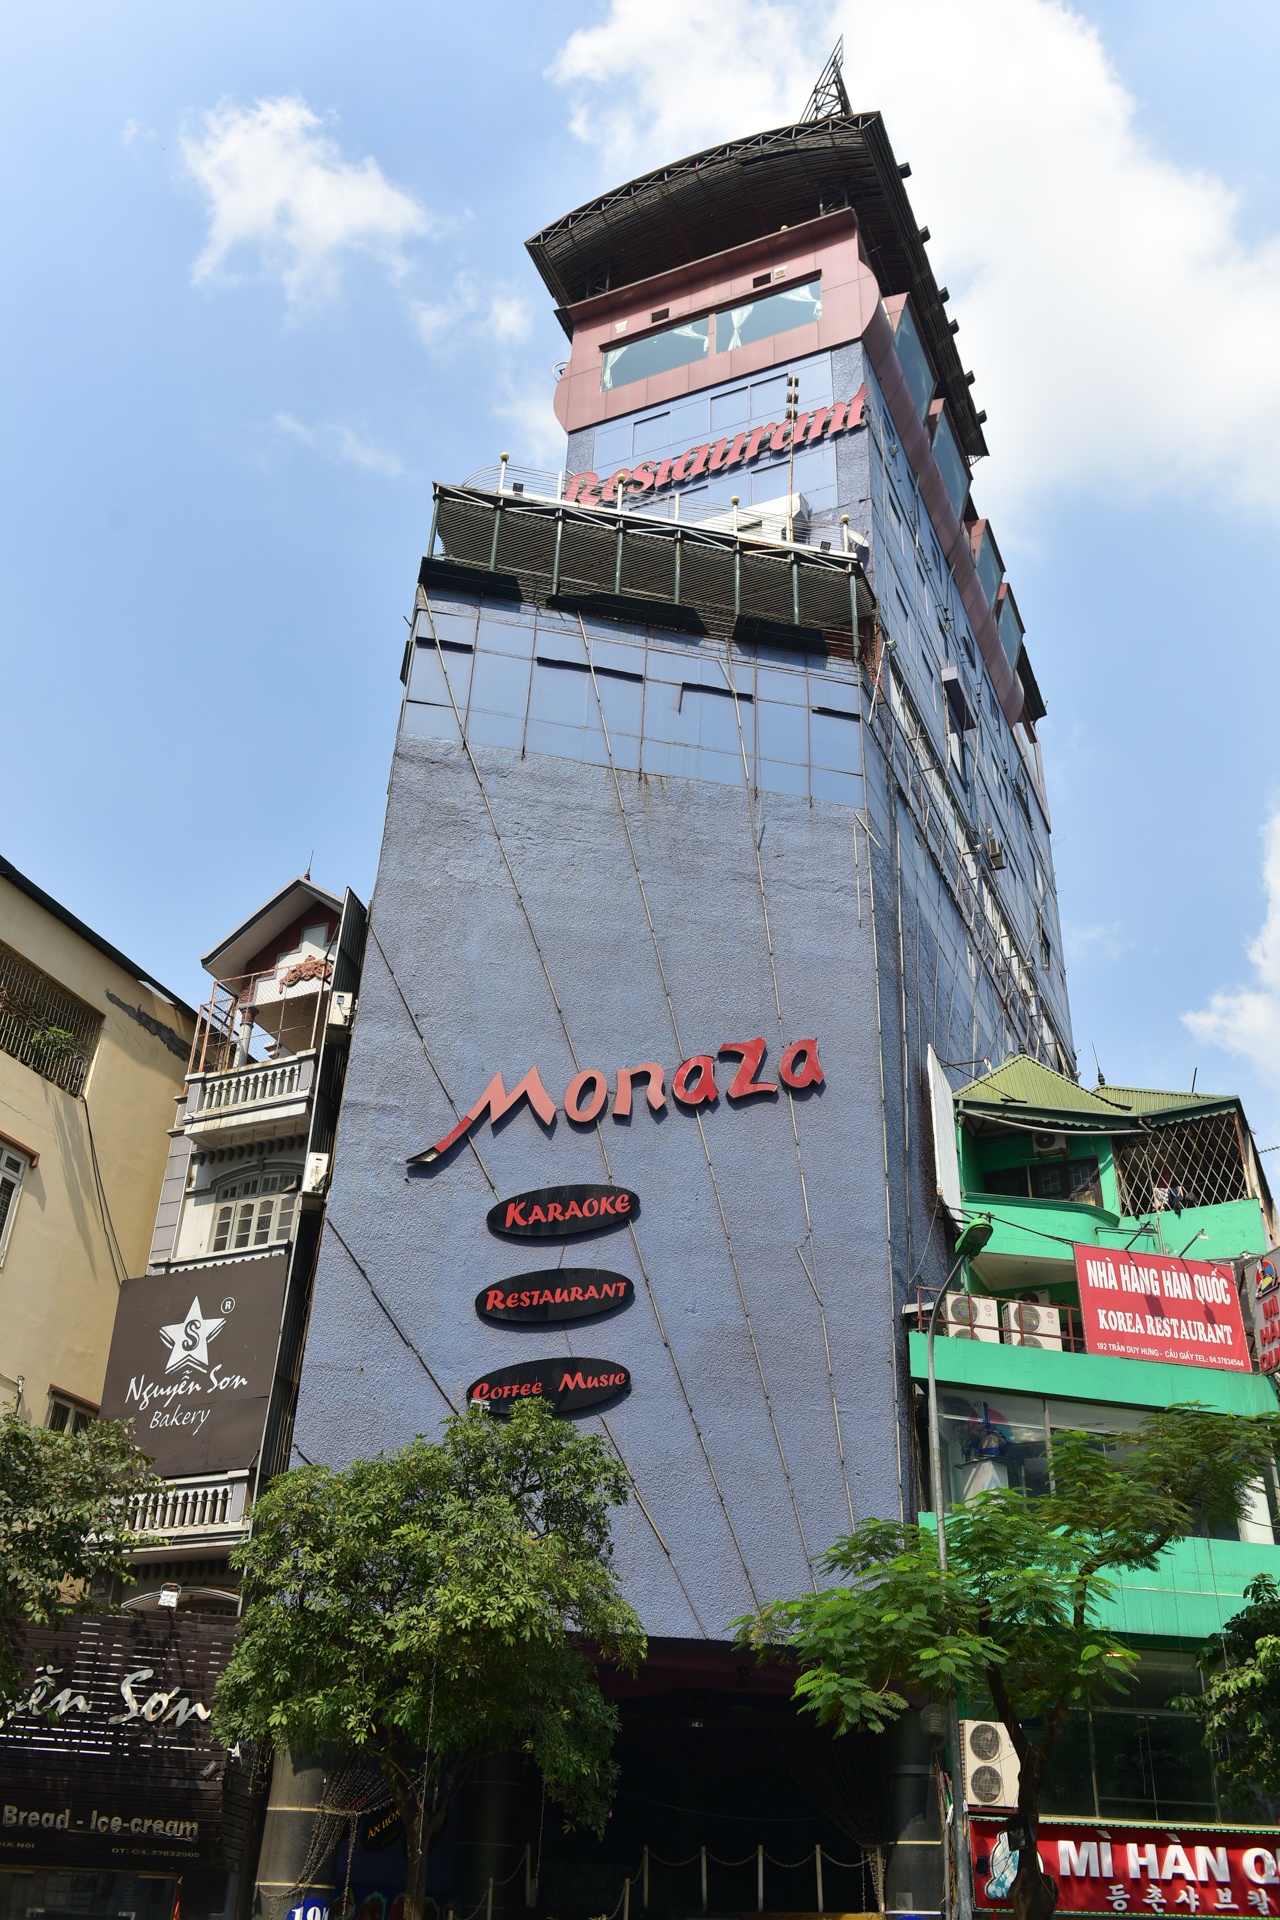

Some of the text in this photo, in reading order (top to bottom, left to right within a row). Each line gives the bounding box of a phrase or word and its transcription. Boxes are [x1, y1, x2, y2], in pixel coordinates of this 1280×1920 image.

[1086, 1257, 1231, 1305] NHÀ HÀNG HÀN QUỐC
[1097, 1308, 1233, 1345] KOREA RESTAURANT
[1097, 1342, 1107, 1351] 192
[1126, 1345, 1141, 1354] DUY
[1195, 1354, 1208, 1363] TEL:
[125, 1364, 248, 1411] Nguyễn Sơn
[150, 1404, 211, 1436] Bakery
[108, 1668, 212, 1727] Sơn
[2, 1804, 71, 1830] Bread
[90, 1809, 199, 1838] Ice-cream
[1057, 1830, 1280, 1884] MÌ HÀN Q
